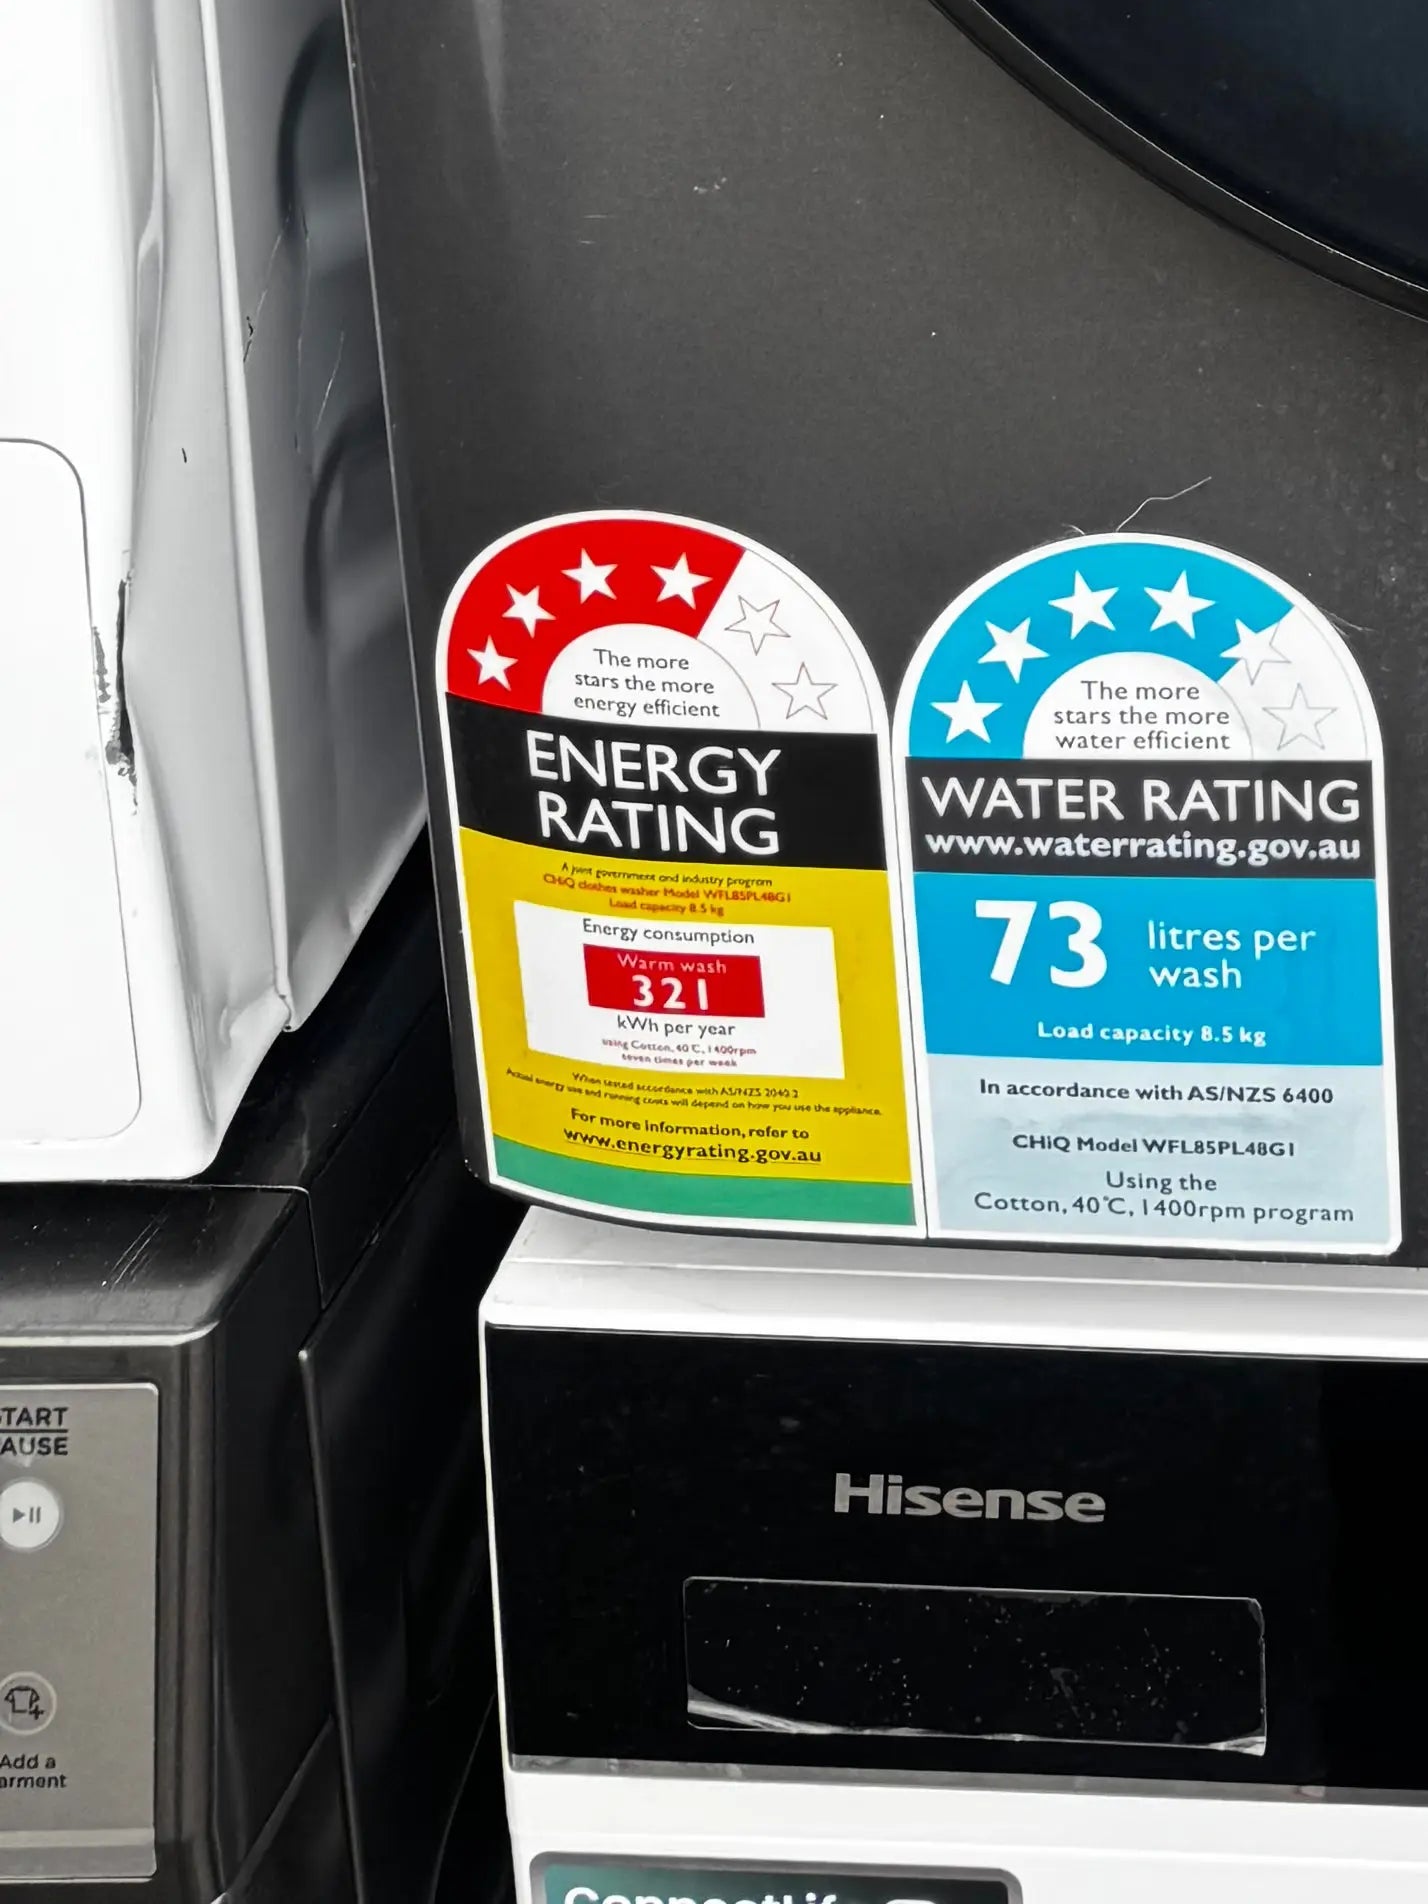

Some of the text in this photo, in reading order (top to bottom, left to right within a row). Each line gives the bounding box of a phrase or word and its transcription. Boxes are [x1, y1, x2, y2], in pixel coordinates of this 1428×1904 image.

[592, 647, 689, 671] The more
[574, 673, 715, 695] stars the more
[1080, 680, 1200, 701] The more
[573, 696, 721, 719] energy efficient
[1053, 705, 1230, 725] stars the more
[1055, 729, 1231, 750] water efficient
[526, 729, 782, 796] ENERGY
[921, 776, 1360, 823] WATER RATING
[537, 790, 780, 857] RATING
[924, 830, 1361, 867] www.waterrating.gov.au
[658, 872, 679, 884] and
[682, 873, 723, 887] industry
[582, 917, 755, 947] Energy consumption
[975, 899, 1108, 988] 73
[1148, 919, 1317, 961] litres per
[617, 953, 727, 974] Warm wash
[1148, 958, 1242, 989] wash
[632, 974, 709, 1011] 321
[617, 1014, 736, 1040] kWh per year
[1037, 1021, 1267, 1048] Load capacity 8.5 kg
[980, 1078, 1334, 1104] In accordance with AS/NZS 6400
[570, 1107, 810, 1140] For more information, refer to
[563, 1127, 822, 1165] www.energyrating.gov.au
[1076, 1136, 1138, 1153] Model
[1141, 1138, 1294, 1157] WFL85PL48G1
[1106, 1170, 1217, 1196] Using the
[974, 1191, 1068, 1215] Cotton,
[1142, 1198, 1246, 1223] 1400rpm
[1253, 1207, 1354, 1226] program
[0, 1406, 69, 1428] TART
[834, 1472, 1106, 1523] Hisense
[0, 1754, 56, 1769] Add a
